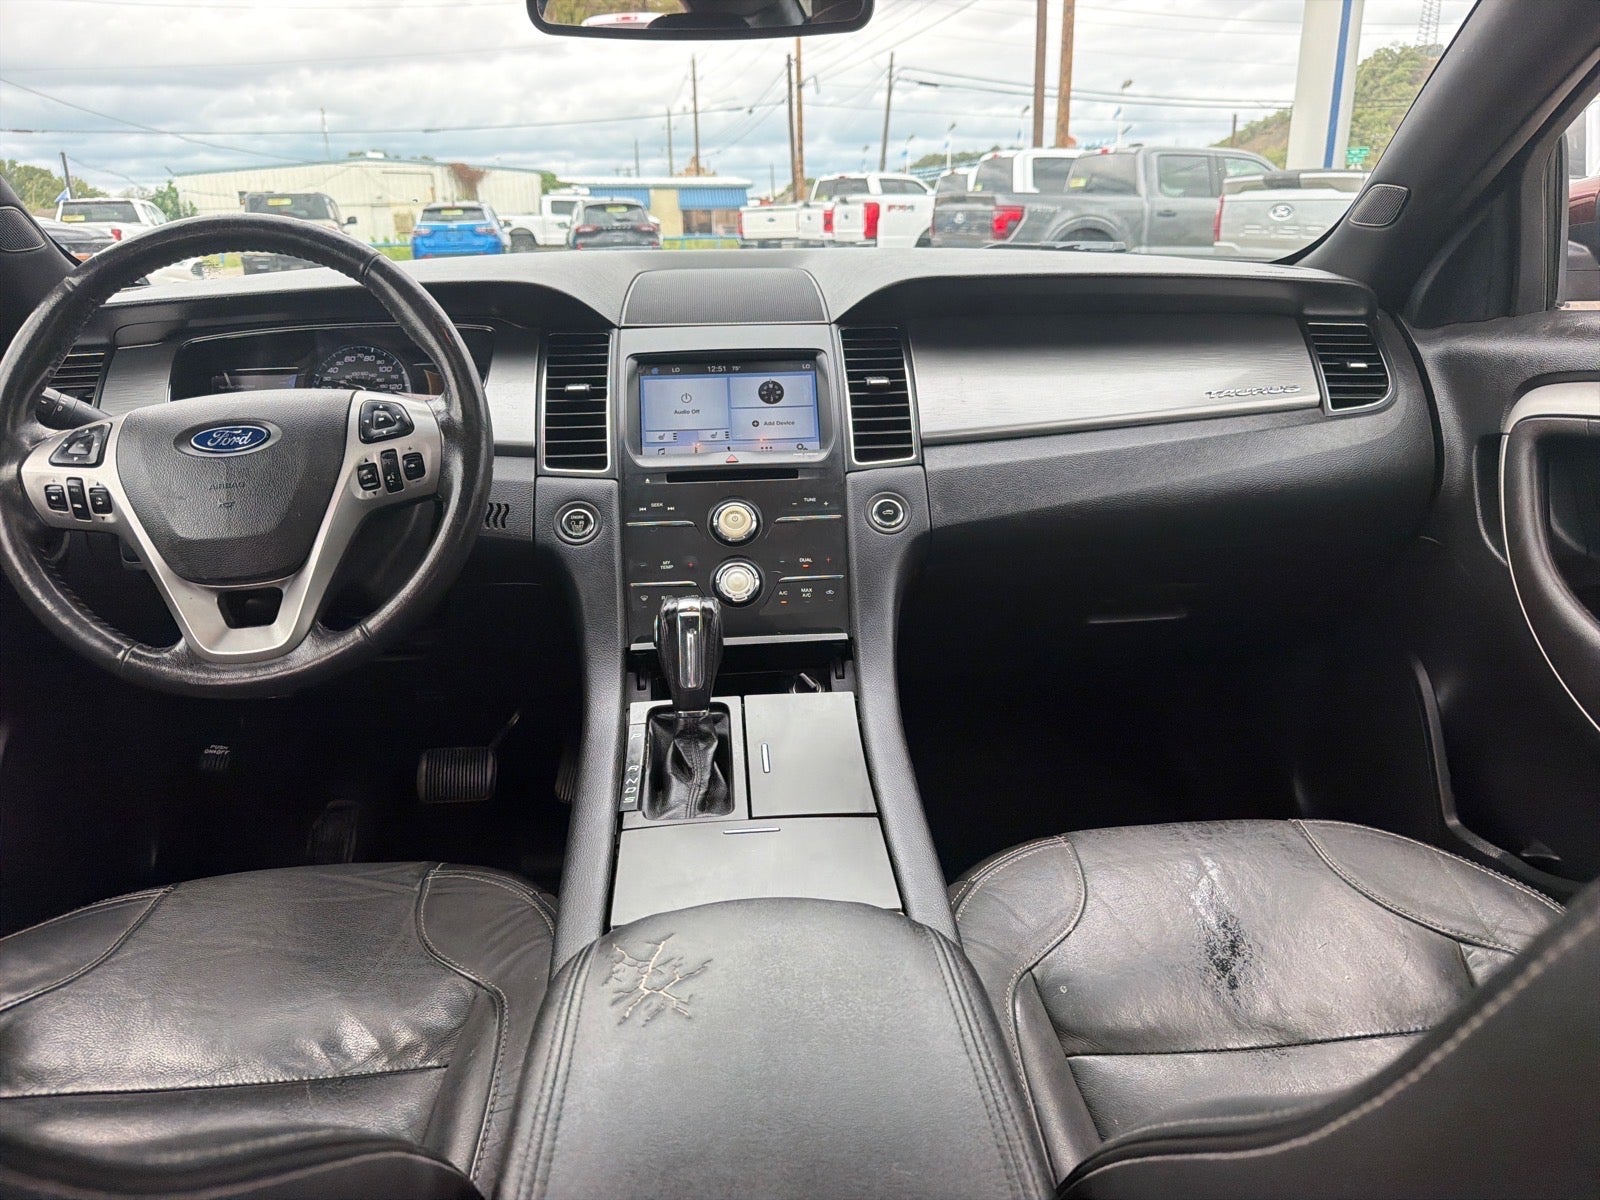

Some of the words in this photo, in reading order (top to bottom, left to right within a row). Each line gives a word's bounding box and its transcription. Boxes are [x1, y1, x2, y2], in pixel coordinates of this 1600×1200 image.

[1205, 384, 1301, 399] TAURUS
[207, 429, 253, 447] Ford
[625, 777, 639, 785] N
[624, 786, 637, 794] D
